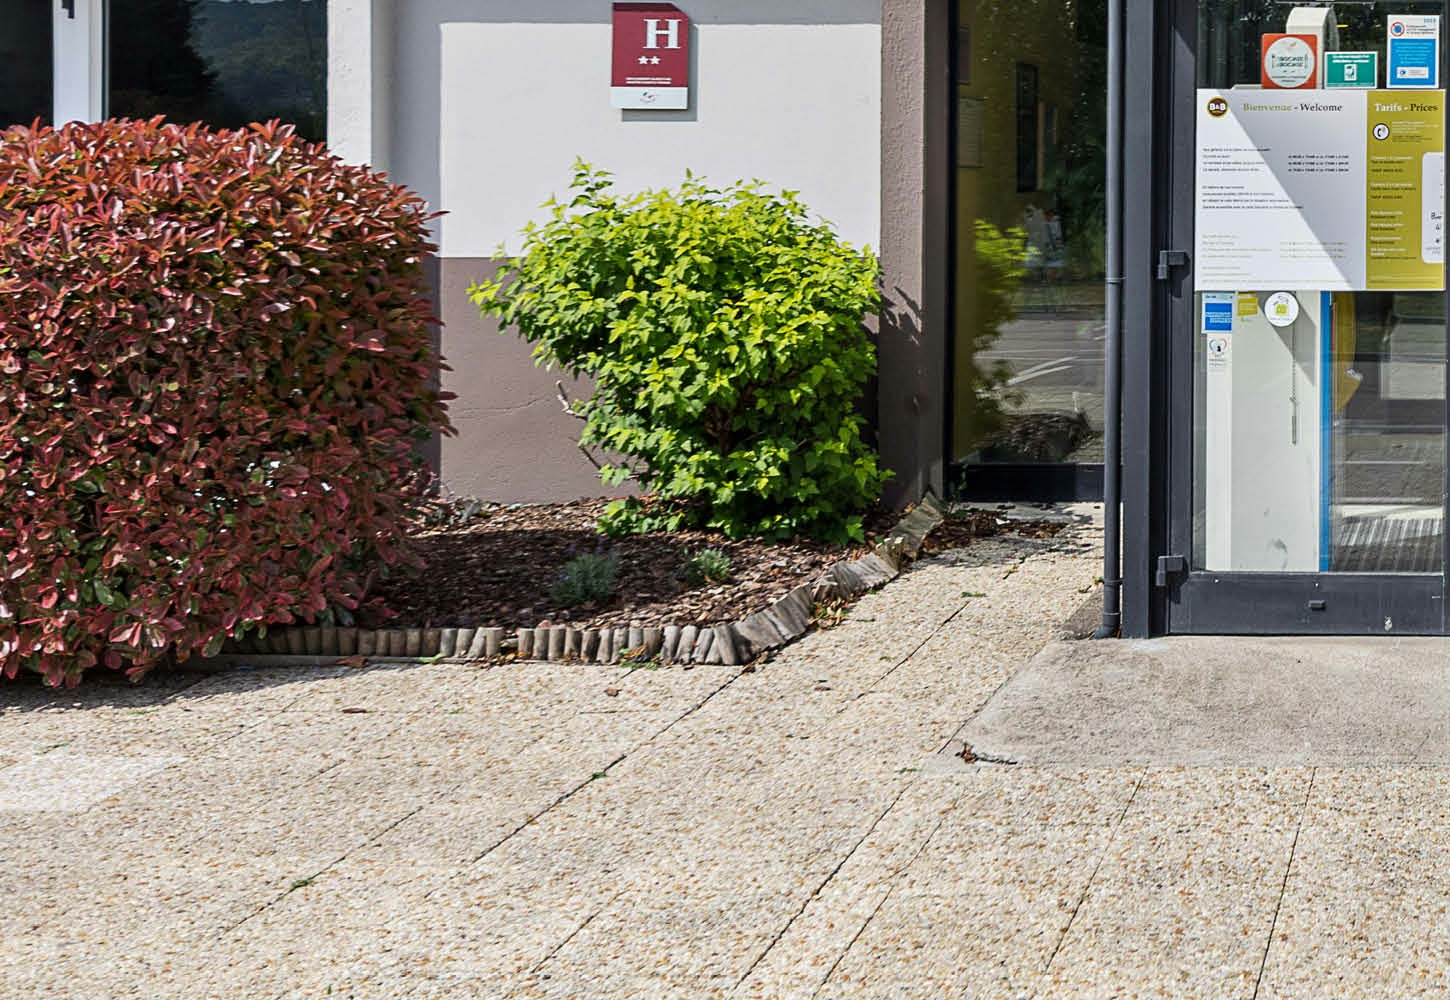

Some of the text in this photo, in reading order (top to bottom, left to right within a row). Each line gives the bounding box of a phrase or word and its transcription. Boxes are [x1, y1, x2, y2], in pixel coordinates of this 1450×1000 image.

[641, 18, 683, 49] H
[1300, 103, 1343, 112] Welcome
[1374, 103, 1402, 112] Tarifs
[1410, 103, 1438, 112] Prices
